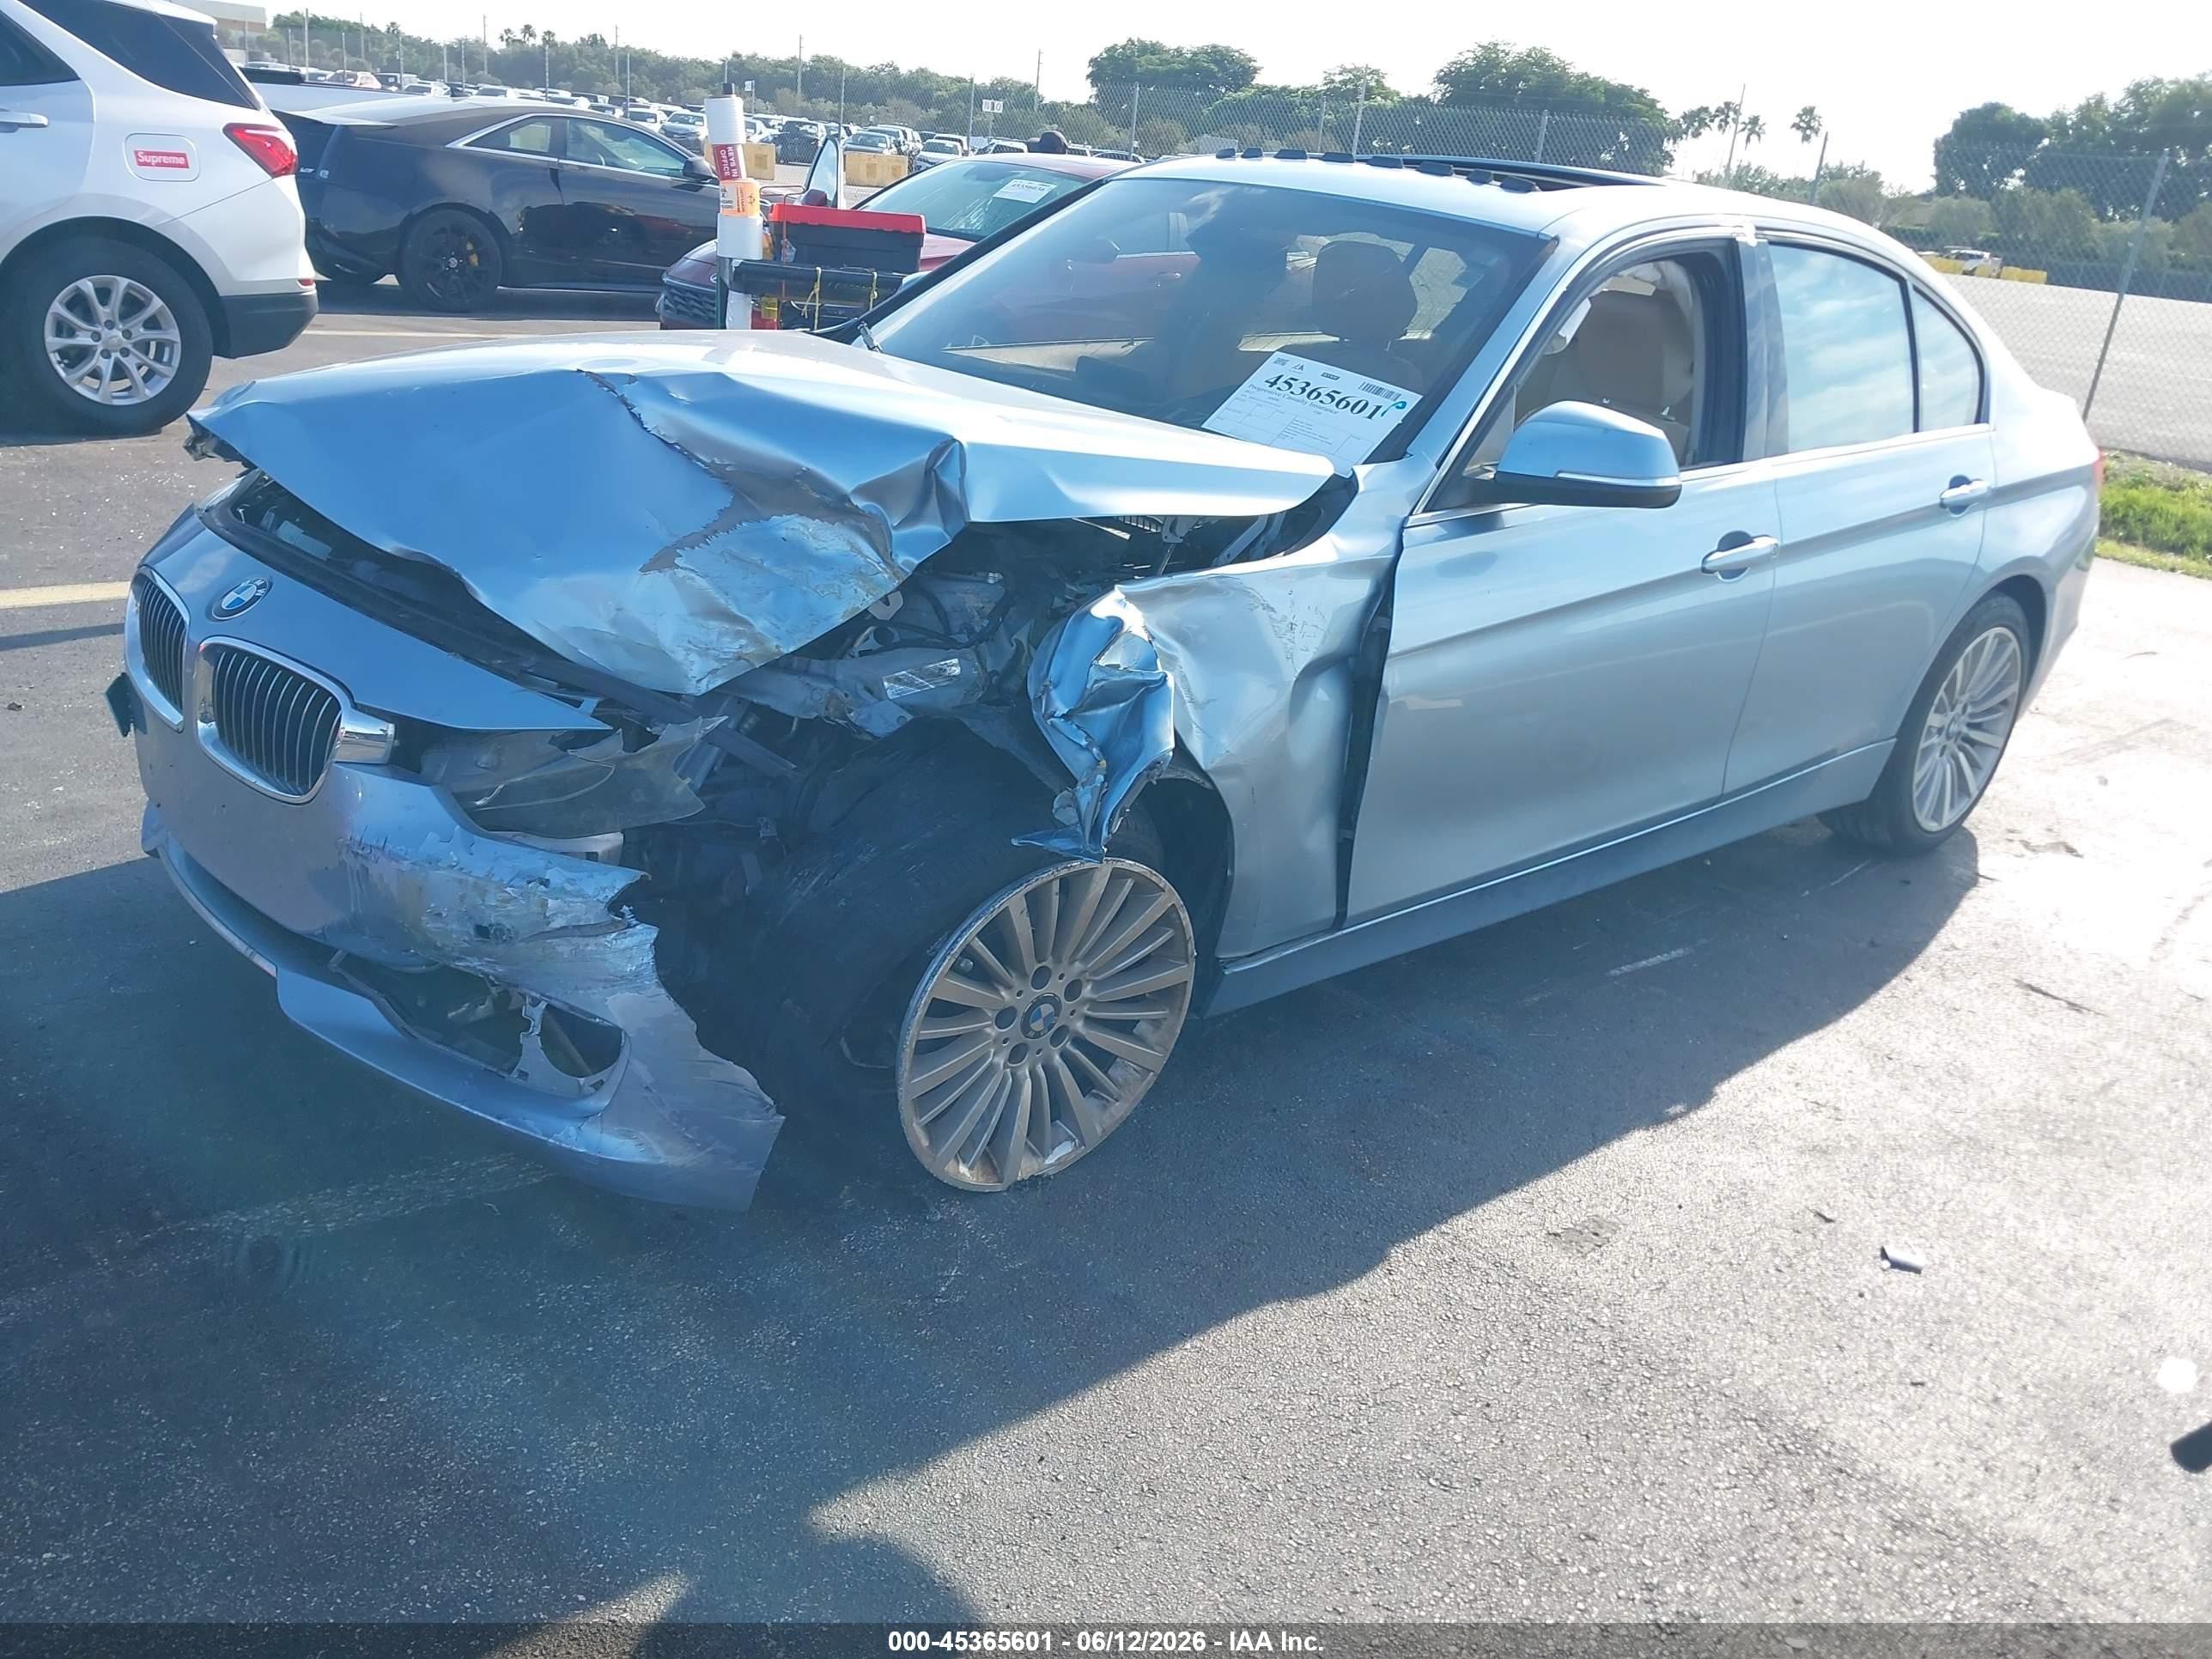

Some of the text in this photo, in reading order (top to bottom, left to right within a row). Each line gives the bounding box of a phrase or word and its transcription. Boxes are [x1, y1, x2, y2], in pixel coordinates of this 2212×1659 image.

[137, 151, 186, 166] Supreme
[720, 149, 731, 177] OFFICE
[726, 146, 737, 167] KEYS
[732, 168, 738, 178] IN
[1264, 374, 1384, 420] 45365601
